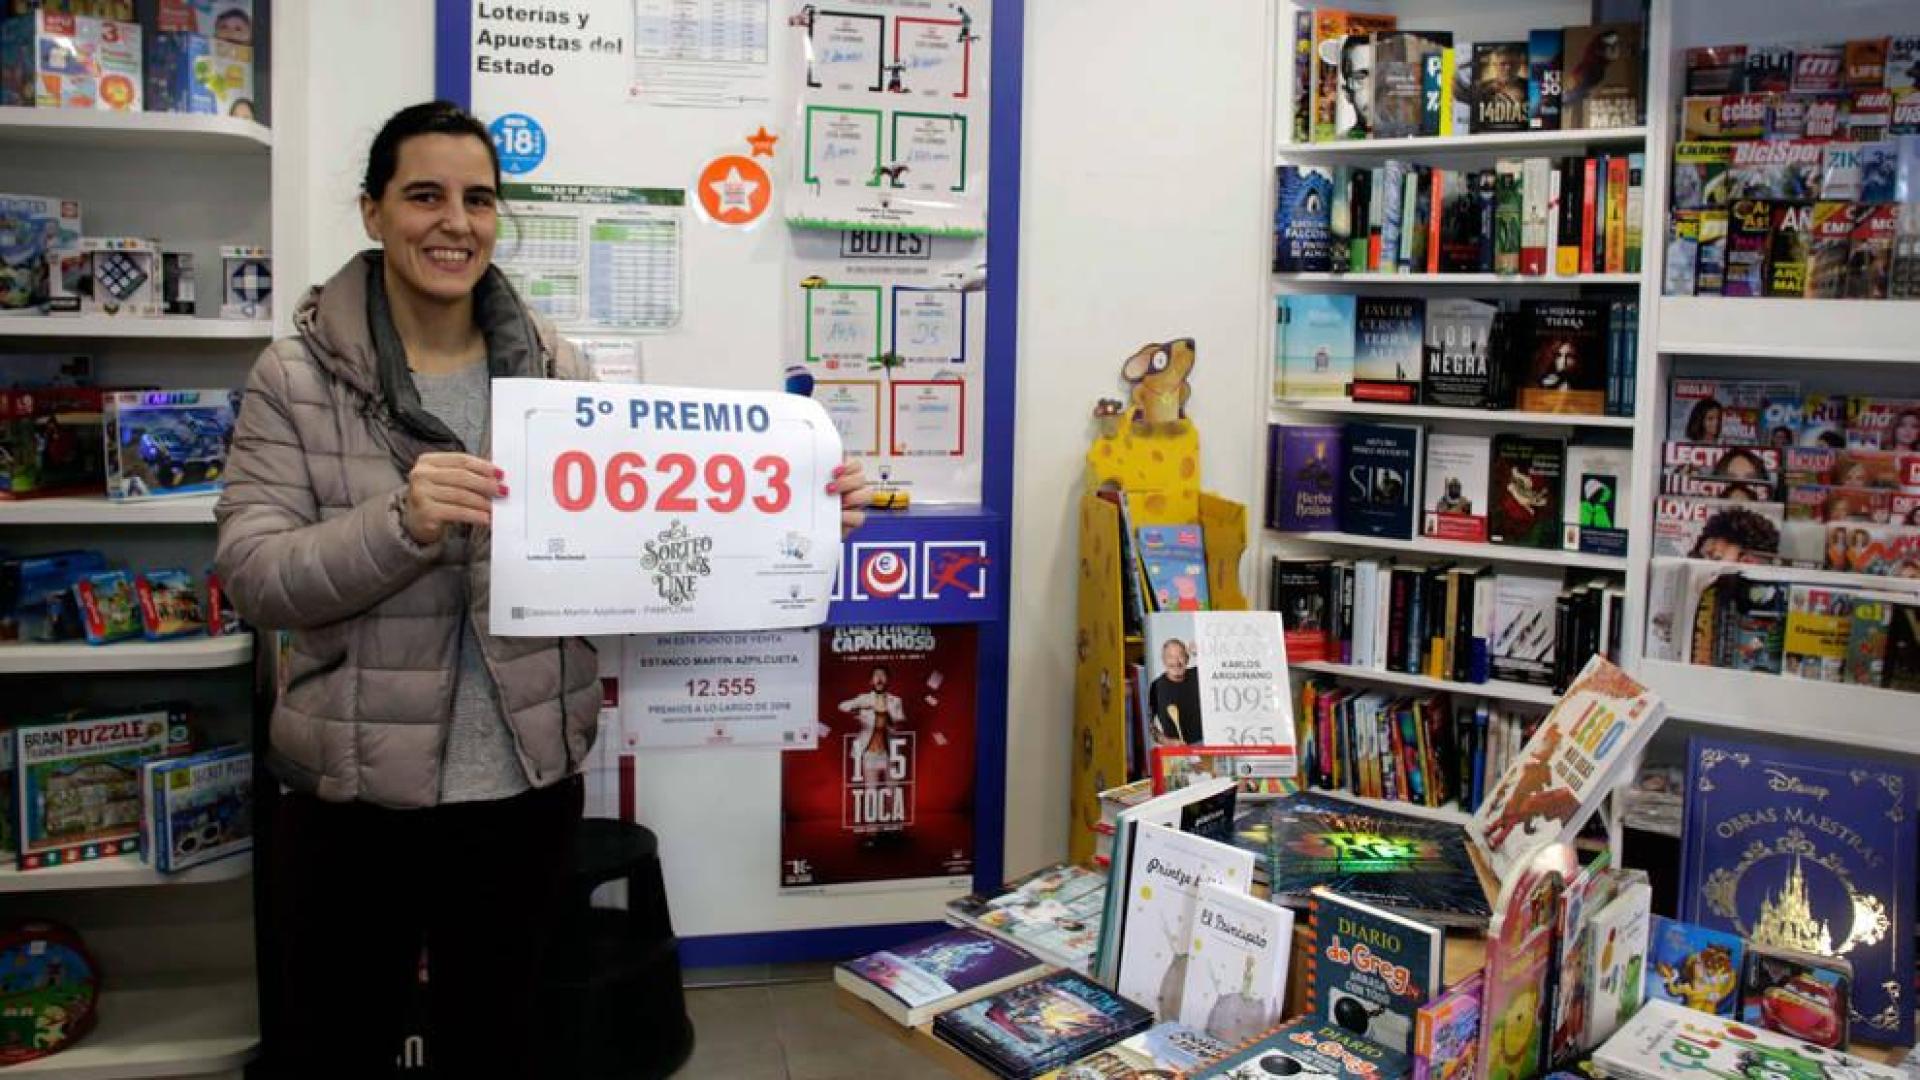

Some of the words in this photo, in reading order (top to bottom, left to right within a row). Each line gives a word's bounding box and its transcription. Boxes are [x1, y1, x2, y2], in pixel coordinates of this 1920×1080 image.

[577, 12, 590, 30] y
[476, 29, 583, 51] Apuestas
[589, 36, 623, 54] del
[476, 55, 555, 77] Estado
[1429, 352, 1488, 376] NEGRA
[629, 399, 771, 434] PREMIO
[551, 448, 793, 515] 06293
[640, 656, 691, 668] ESTANCO
[685, 677, 756, 698] 12.555
[24, 730, 64, 749] BRAIN
[65, 720, 145, 748] PUZZLE
[1763, 767, 1831, 802] Disney
[851, 785, 906, 825] TOCA
[1716, 807, 1779, 838] OBRAS
[1783, 806, 1885, 868] MAESTRAS
[1337, 916, 1402, 952] DIARIO
[1325, 934, 1351, 966] de
[1351, 942, 1412, 996] Greg
